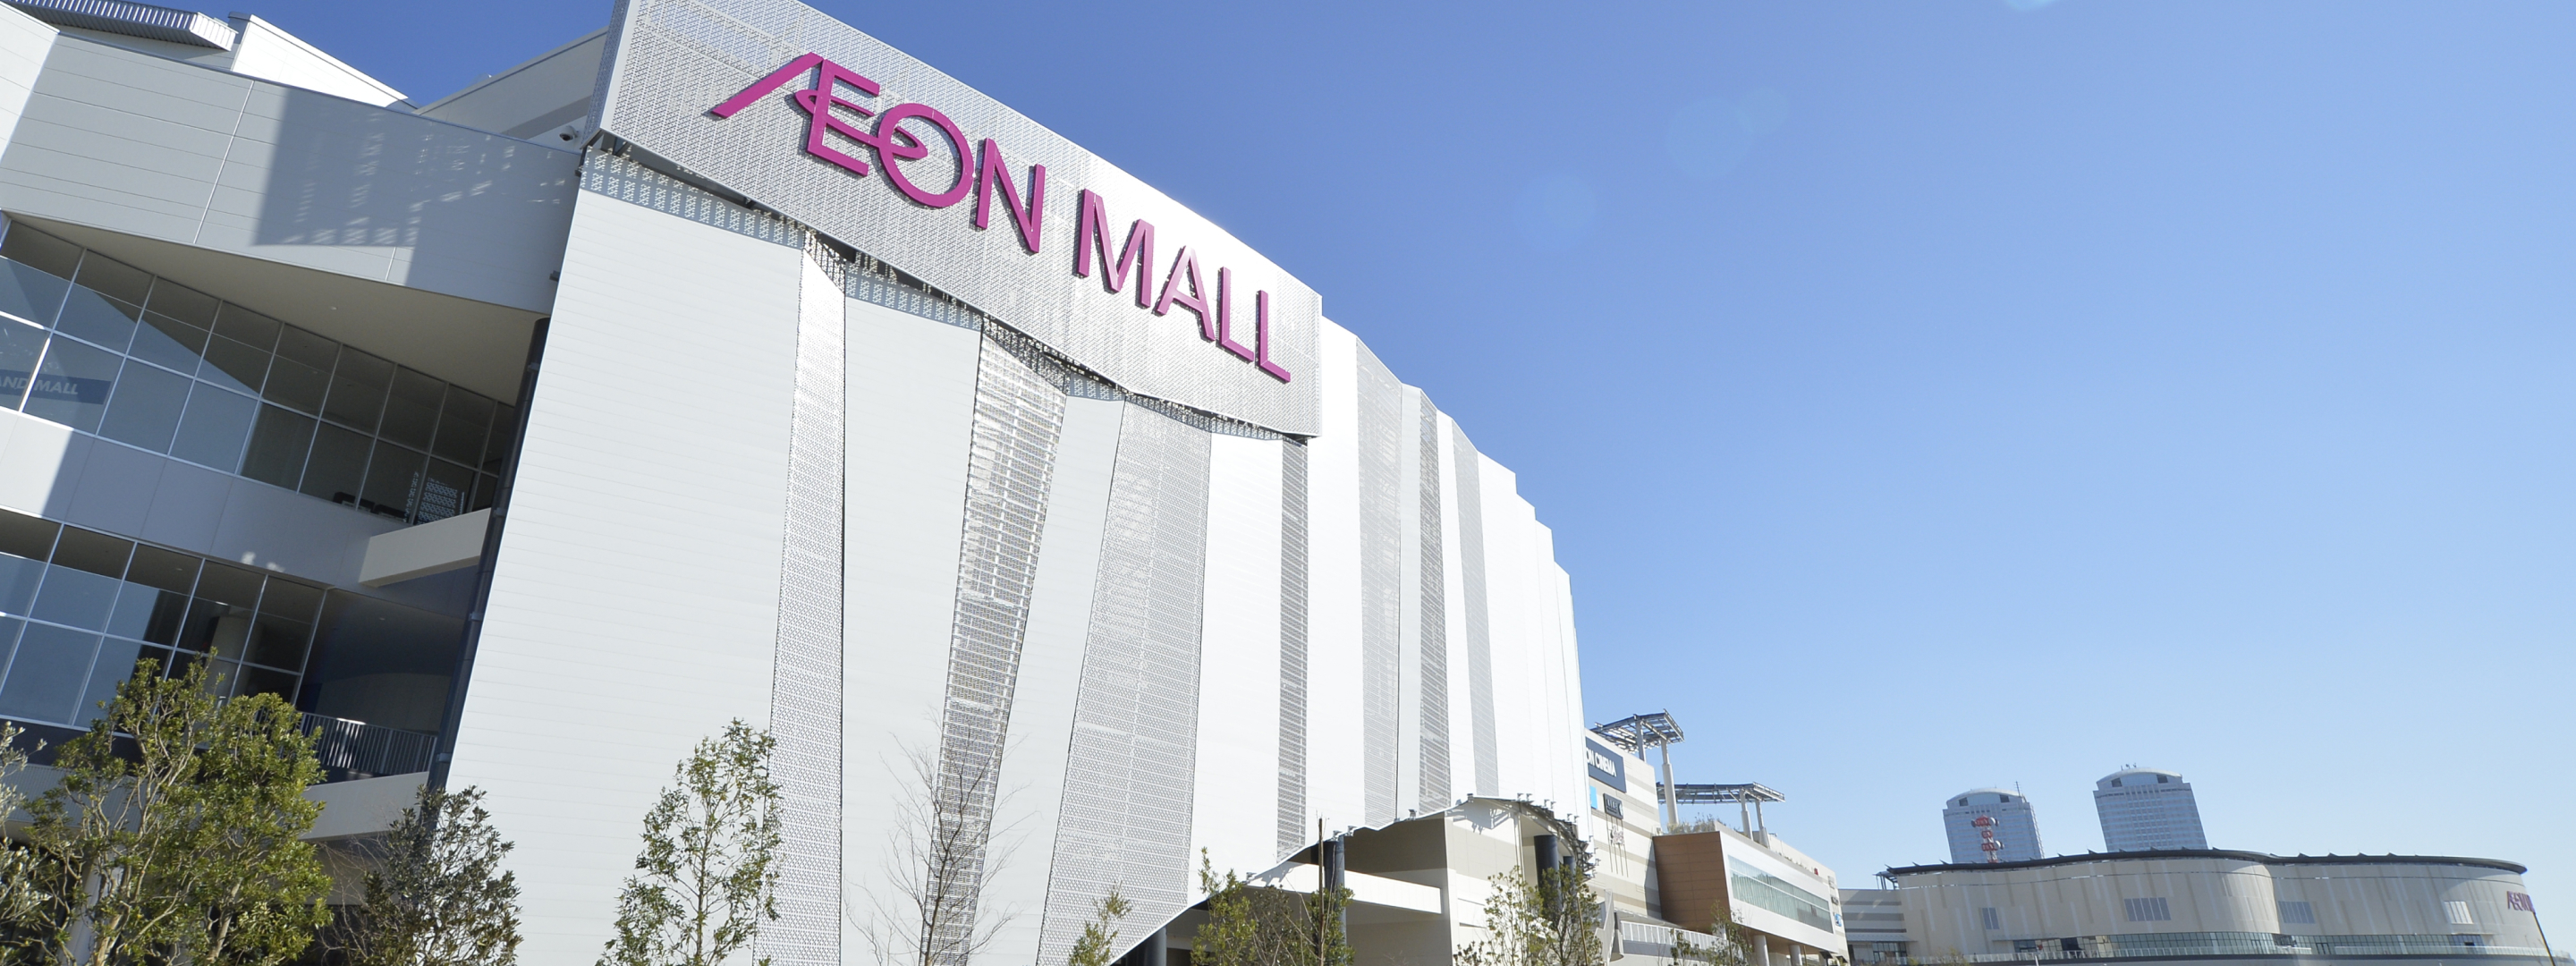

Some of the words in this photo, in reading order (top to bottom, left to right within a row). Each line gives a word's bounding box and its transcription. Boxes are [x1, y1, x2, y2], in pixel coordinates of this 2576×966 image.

[1076, 189, 1291, 383] MALL
[34, 379, 79, 395] MALL
[1595, 752, 1617, 777] CINEMA
